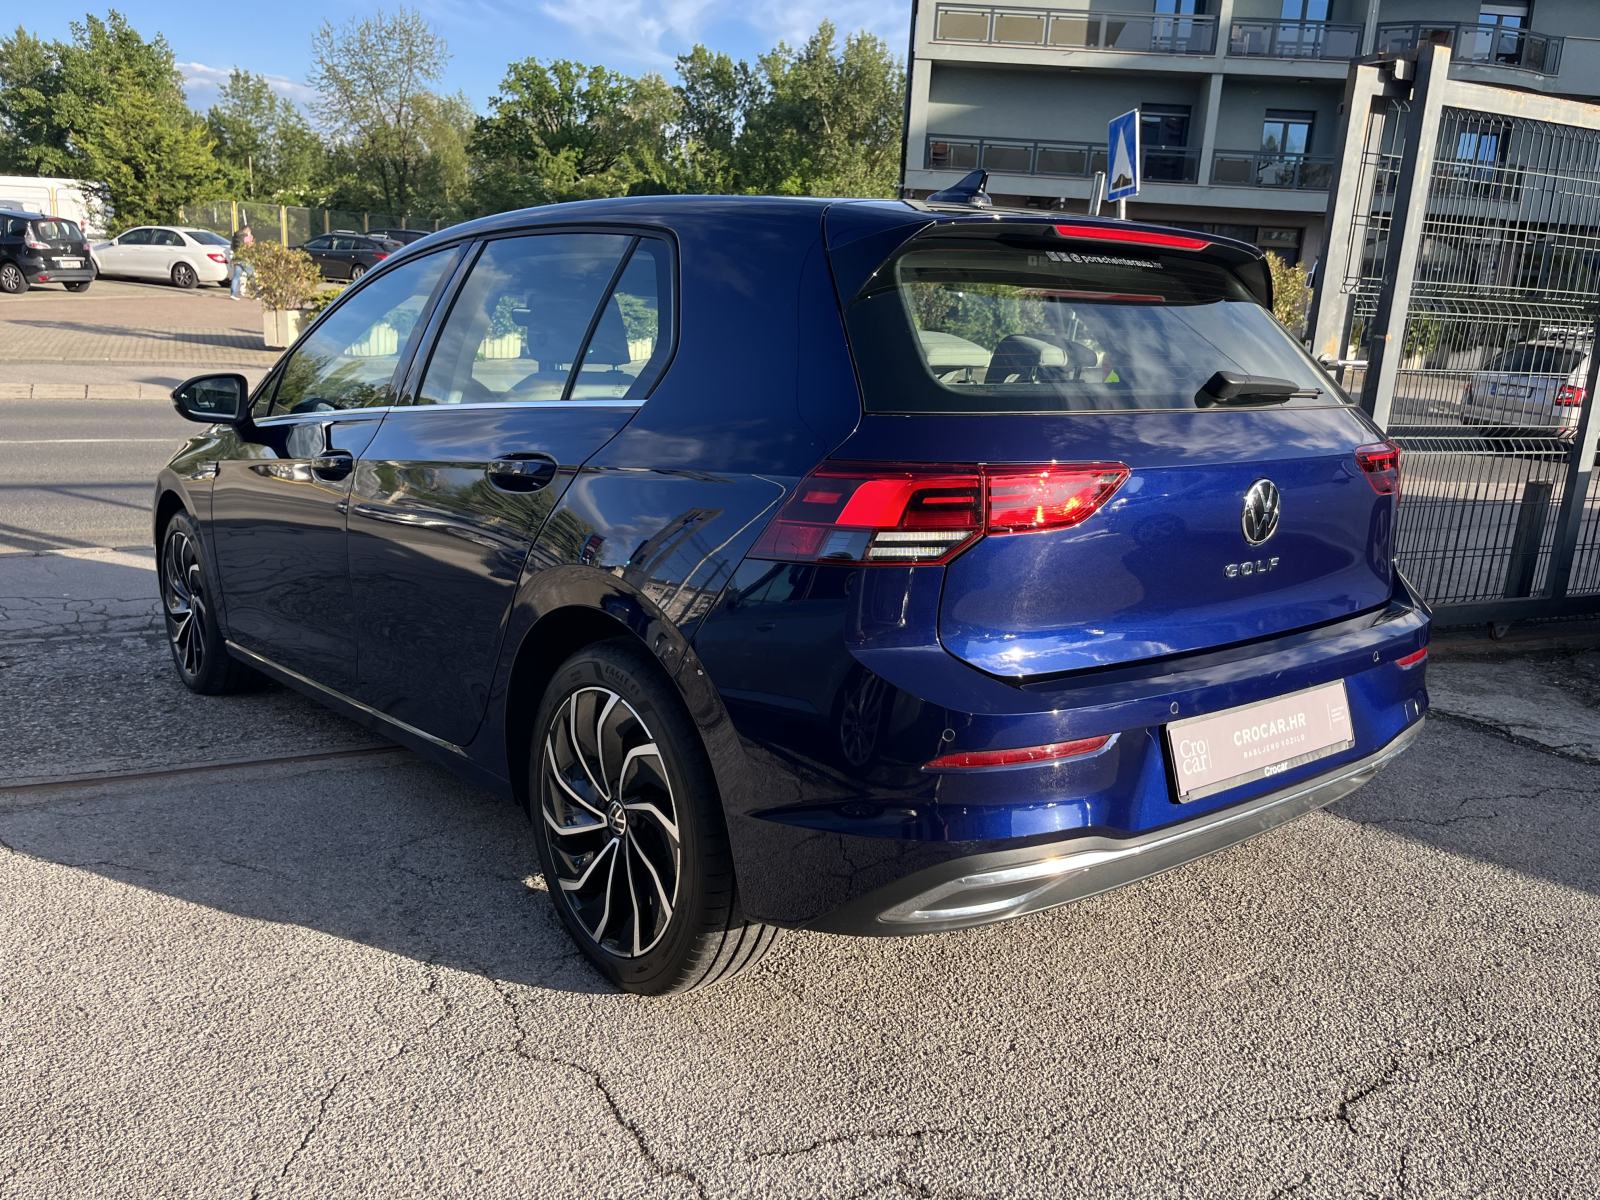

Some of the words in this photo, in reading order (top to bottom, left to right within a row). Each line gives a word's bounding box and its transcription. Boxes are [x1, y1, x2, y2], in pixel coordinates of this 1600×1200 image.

[1224, 557, 1280, 578] GOLF
[1233, 712, 1307, 746] CROCAR.HR
[1179, 739, 1206, 760] Cro
[1182, 754, 1208, 776] car
[1264, 761, 1289, 777] Crocar
